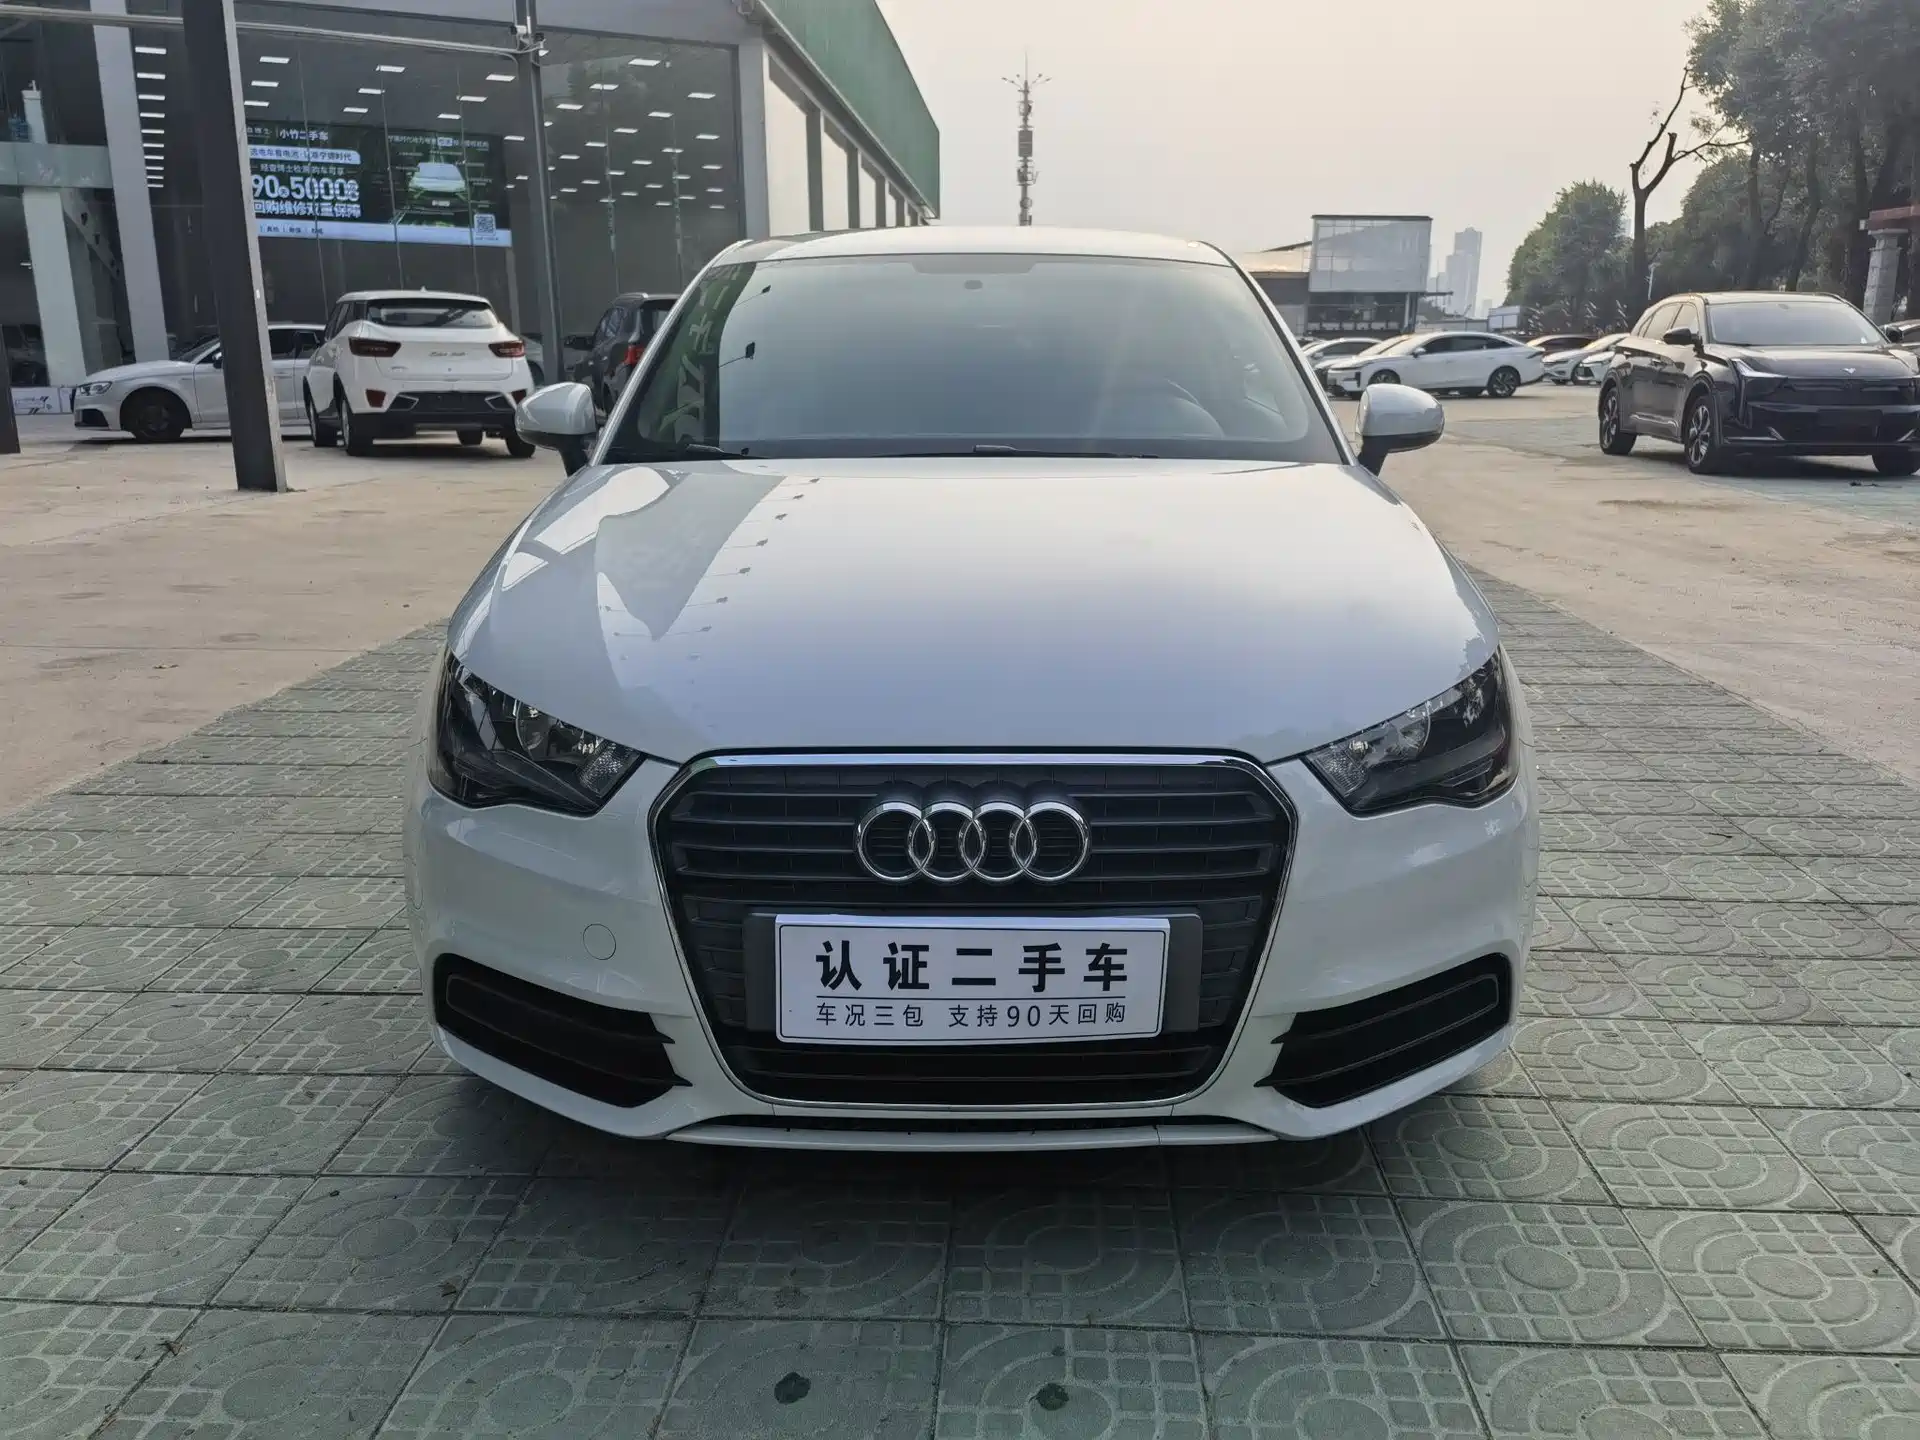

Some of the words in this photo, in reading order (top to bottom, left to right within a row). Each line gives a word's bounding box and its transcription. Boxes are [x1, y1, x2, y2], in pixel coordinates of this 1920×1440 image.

[280, 129, 329, 141] 小竹二手车
[816, 940, 1128, 993] 认证二手车
[816, 1002, 924, 1027] 车况三包
[949, 1001, 1126, 1027] 支持90天回购
